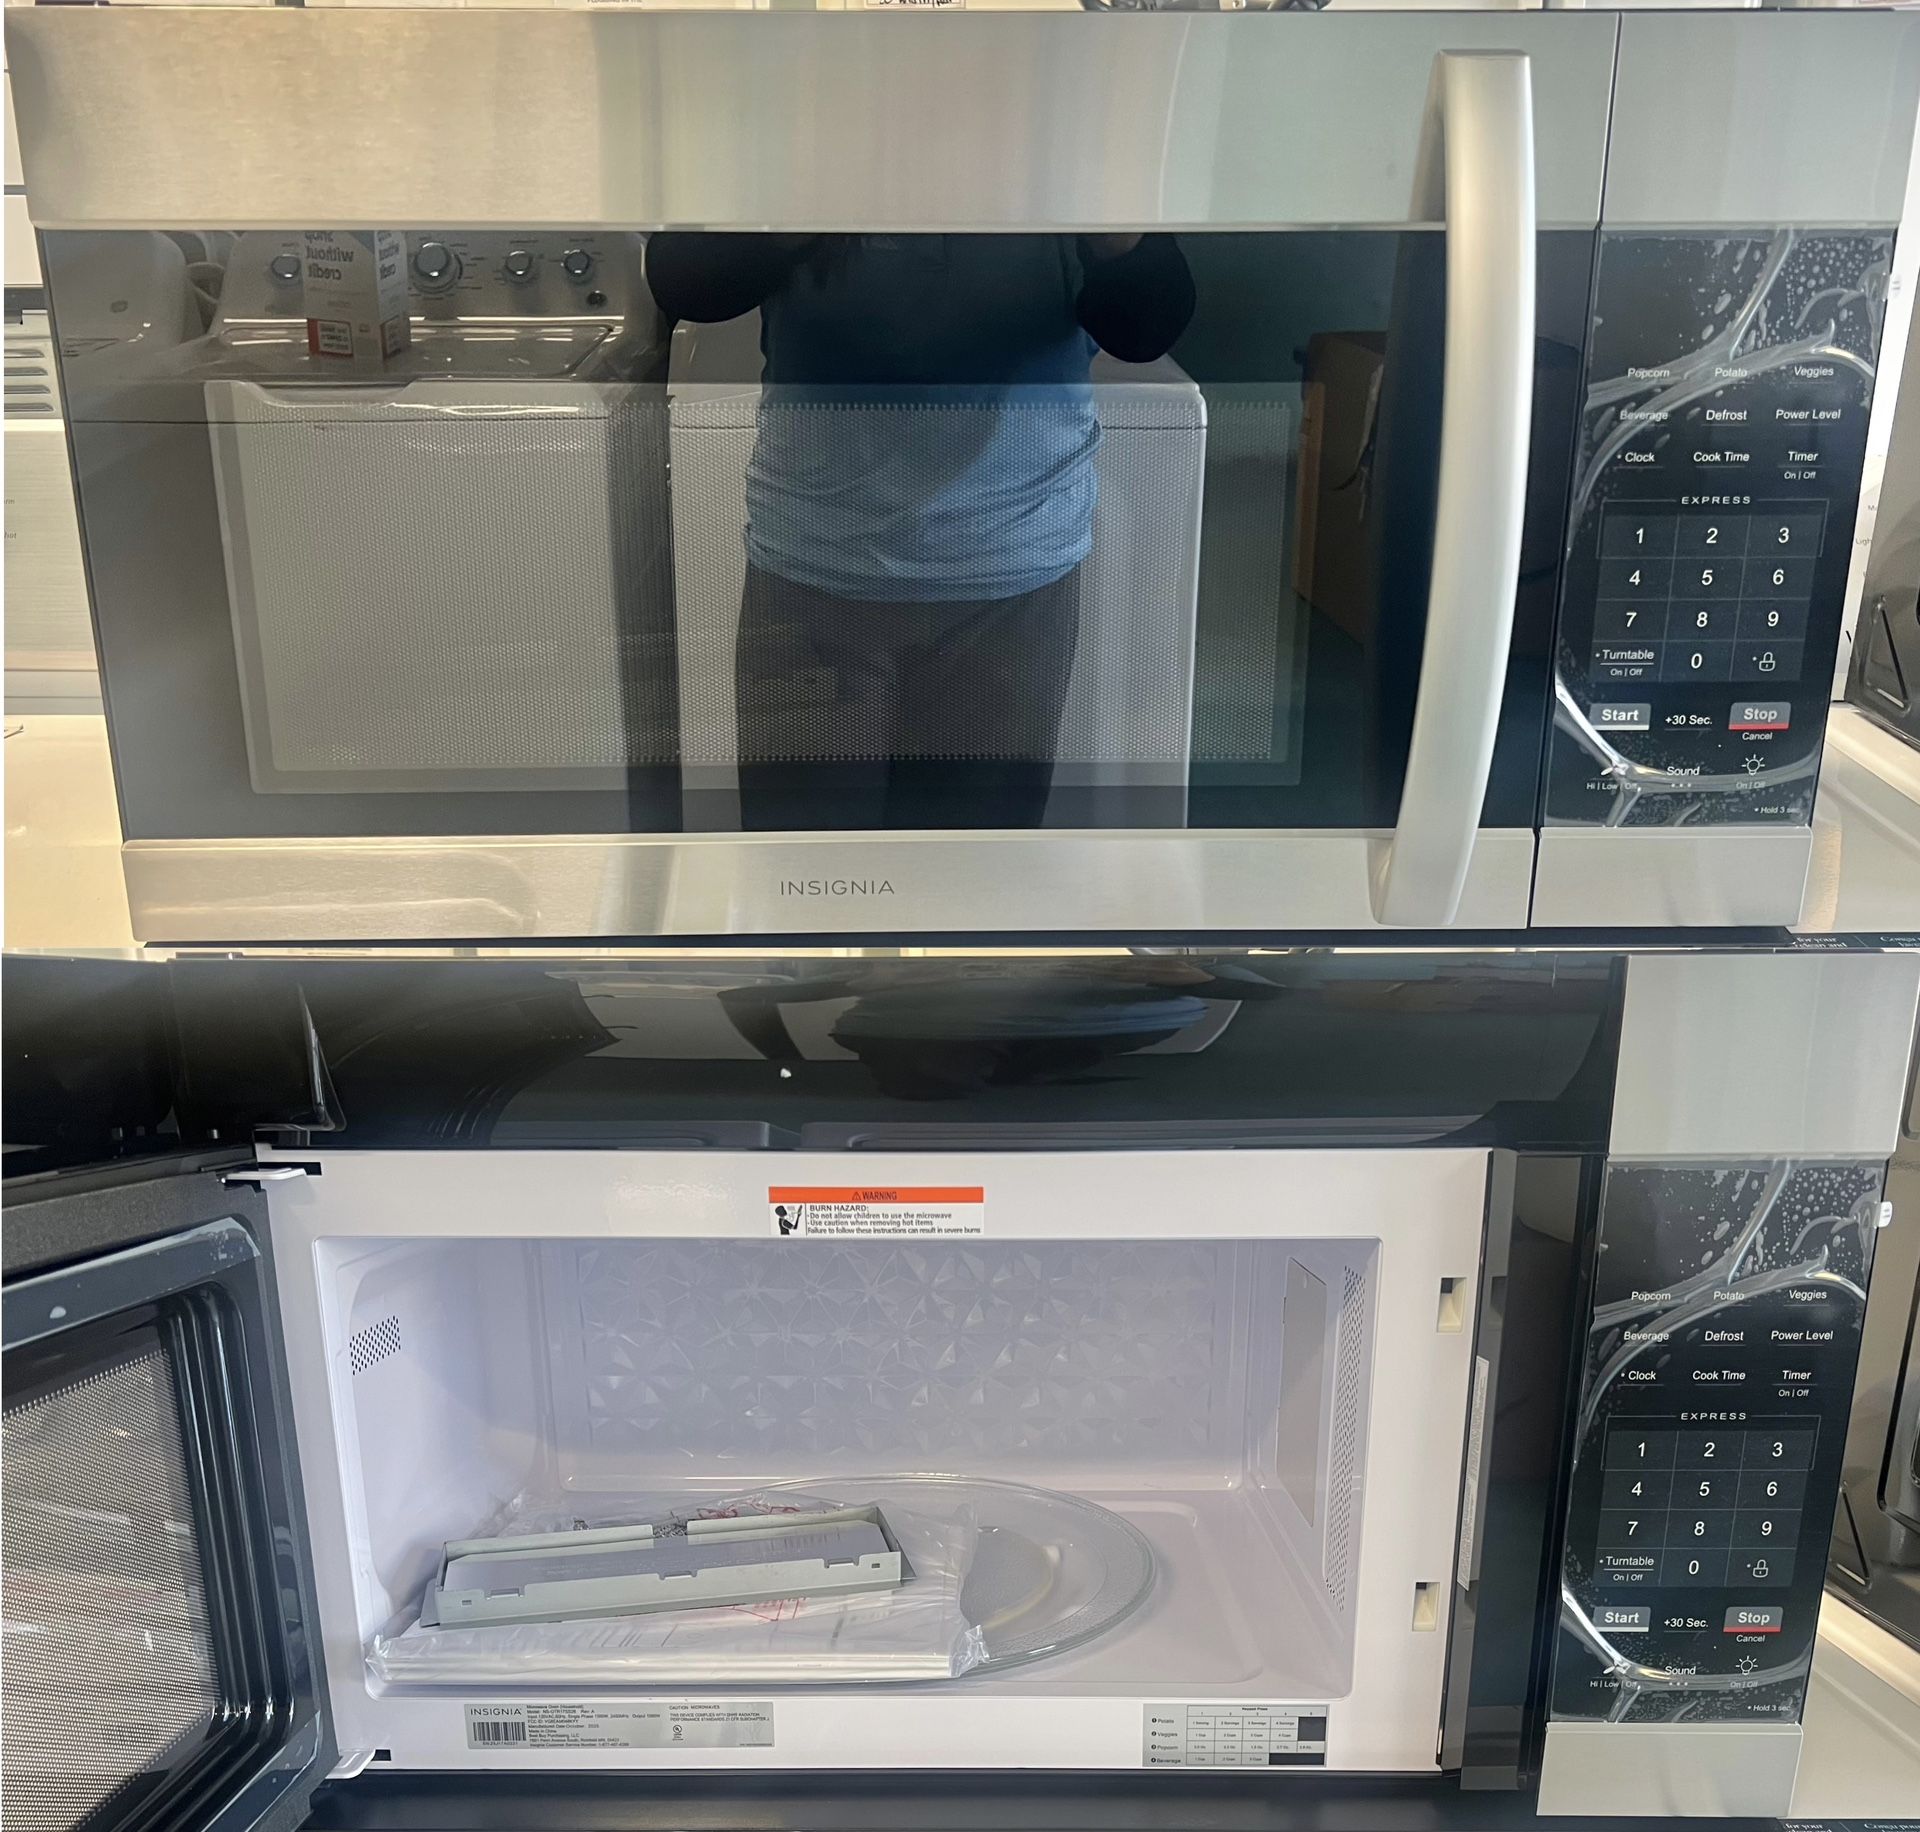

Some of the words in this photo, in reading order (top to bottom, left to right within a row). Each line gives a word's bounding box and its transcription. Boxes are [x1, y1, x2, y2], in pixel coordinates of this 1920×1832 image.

[1627, 366, 1670, 379] Popcorn
[1714, 366, 1748, 378] Potato
[1794, 366, 1834, 379] Veggies
[1620, 409, 1669, 422] Beverage
[1705, 409, 1747, 421] Defrost
[1775, 409, 1809, 420] Power
[1812, 408, 1841, 420] Level
[1625, 451, 1655, 462] Clock
[1693, 451, 1720, 462] Cook
[1723, 451, 1750, 462] Time
[1788, 451, 1819, 462] Timer
[1784, 472, 1796, 480] On
[1803, 471, 1816, 480] Off
[1681, 496, 1751, 505] EXPRESS
[1635, 528, 1645, 544] 1
[1706, 528, 1719, 544] 2
[1778, 528, 1790, 544] 3
[1629, 570, 1642, 586] 4
[1701, 570, 1714, 586] 5
[1773, 569, 1785, 585] 6
[1626, 611, 1637, 628] 7
[1696, 611, 1709, 628] 8
[1767, 611, 1780, 627] 9
[1602, 649, 1655, 661] Turntable
[1690, 653, 1703, 669] 0
[1610, 668, 1622, 676] On
[1629, 668, 1643, 676] Off
[1601, 709, 1639, 722] Start
[1665, 715, 1686, 725] +30
[1689, 715, 1713, 725] Sec.
[1743, 708, 1778, 722] Stop
[1742, 732, 1773, 741] Cancel
[1666, 766, 1700, 776] Sound
[1586, 782, 1595, 790] Hi
[1602, 782, 1618, 790] Low
[1760, 806, 1777, 814] Hold
[1780, 806, 1785, 814] 3
[781, 879, 895, 896] INSIGNIA
[863, 1191, 897, 1201] WARNING
[870, 1219, 901, 1228] removing
[1631, 1291, 1671, 1302] Popcorn
[1713, 1291, 1745, 1301] Potato
[1789, 1290, 1827, 1301] Veggies
[1623, 1331, 1670, 1342] Beverage
[1704, 1331, 1744, 1341] Defrost
[1771, 1330, 1804, 1341] Power
[1806, 1330, 1833, 1341] Level
[1628, 1371, 1656, 1380] Clock
[1692, 1371, 1719, 1380] Cook
[1721, 1371, 1746, 1380] Time
[1782, 1370, 1811, 1380] Timer
[1778, 1389, 1790, 1397] On
[1796, 1389, 1809, 1397] Off
[1680, 1412, 1747, 1421] EXPRESS
[1637, 1442, 1646, 1458] 1
[1703, 1442, 1715, 1458] 2
[1772, 1442, 1783, 1457] 3
[1631, 1482, 1642, 1496] 4
[1699, 1481, 1710, 1496] 5
[1766, 1481, 1778, 1496] 6
[1628, 1521, 1638, 1536] 7
[1694, 1521, 1705, 1536] 8
[1761, 1521, 1772, 1536] 9
[1606, 1556, 1654, 1566] Turntable
[1689, 1560, 1699, 1575] 0
[1604, 1612, 1639, 1623] Start
[1664, 1618, 1683, 1628] +30
[1686, 1618, 1708, 1628] Sec.
[1738, 1612, 1770, 1626] Stop
[1736, 1634, 1765, 1643] Cancel
[1665, 1666, 1696, 1675] Sound
[1590, 1680, 1598, 1688] Hi
[1604, 1680, 1619, 1688] Low
[470, 1708, 522, 1716] INSIGNIA
